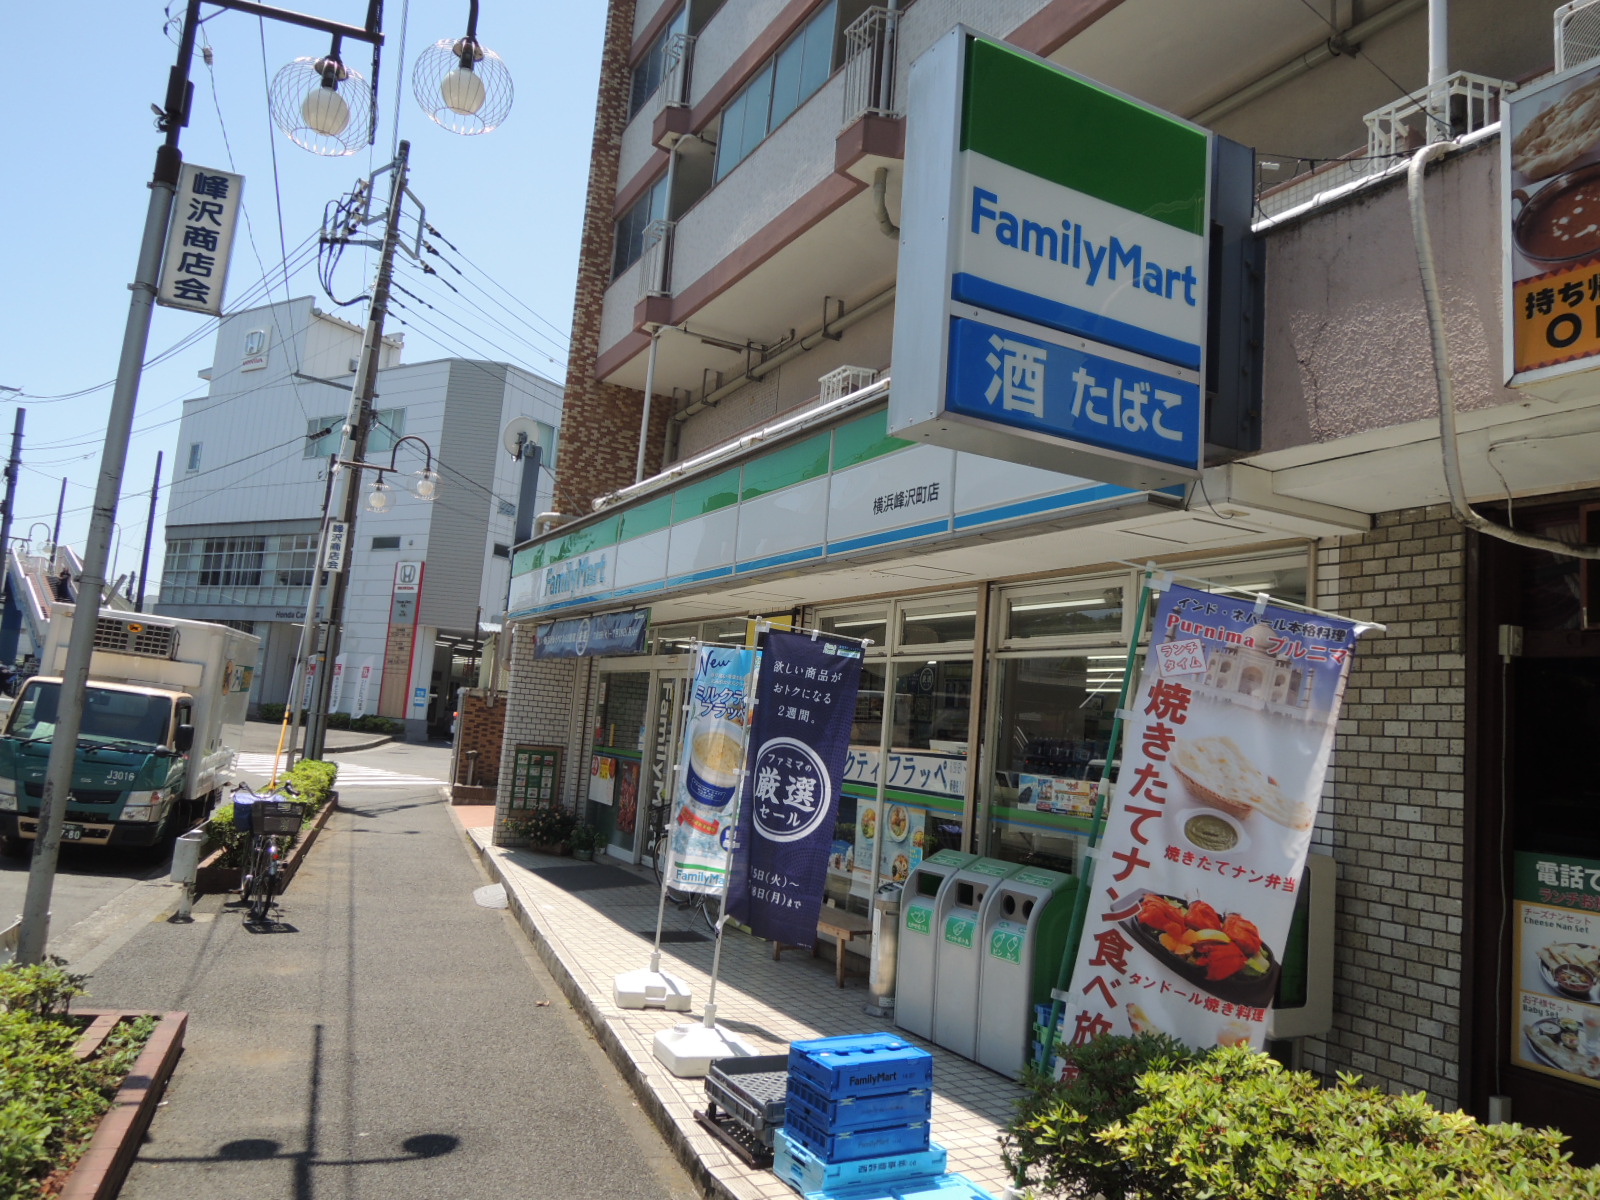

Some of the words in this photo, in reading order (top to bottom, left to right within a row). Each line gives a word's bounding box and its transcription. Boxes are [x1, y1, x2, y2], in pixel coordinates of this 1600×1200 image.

[173, 172, 229, 304] 峰沢商店会
[970, 186, 1197, 306] FamilyMart
[984, 333, 1048, 419] 酒
[1071, 366, 1183, 441] たばこ
[873, 482, 940, 516] 横浜峰沢町店
[327, 523, 345, 570] 峰沢商店会
[544, 553, 606, 598] FamilyMart
[275, 610, 295, 619] Honda
[296, 611, 307, 619] Car
[1161, 641, 1199, 658] ランチ
[1167, 613, 1255, 649] Purnima
[1268, 636, 1350, 664] プルニマ
[695, 650, 731, 681] New
[773, 660, 843, 683] 欲しい商品が
[1164, 656, 1203, 673] タイム
[773, 683, 832, 704] おトクになる
[768, 753, 812, 773] ファミマの
[889, 756, 948, 790] フラッペ
[755, 765, 817, 812] 厳選
[760, 804, 801, 827] セール
[676, 869, 726, 885] FamilyMa
[1164, 845, 1296, 893] 焼きたてナン弁当
[750, 884, 802, 909] 8日(月)まで
[1524, 917, 1555, 928] Cheese
[1556, 923, 1573, 932] Nan
[1574, 925, 1589, 934] Set
[1128, 972, 1266, 1023] タンドール焼き料理
[850, 1071, 897, 1087] FamilyMart
